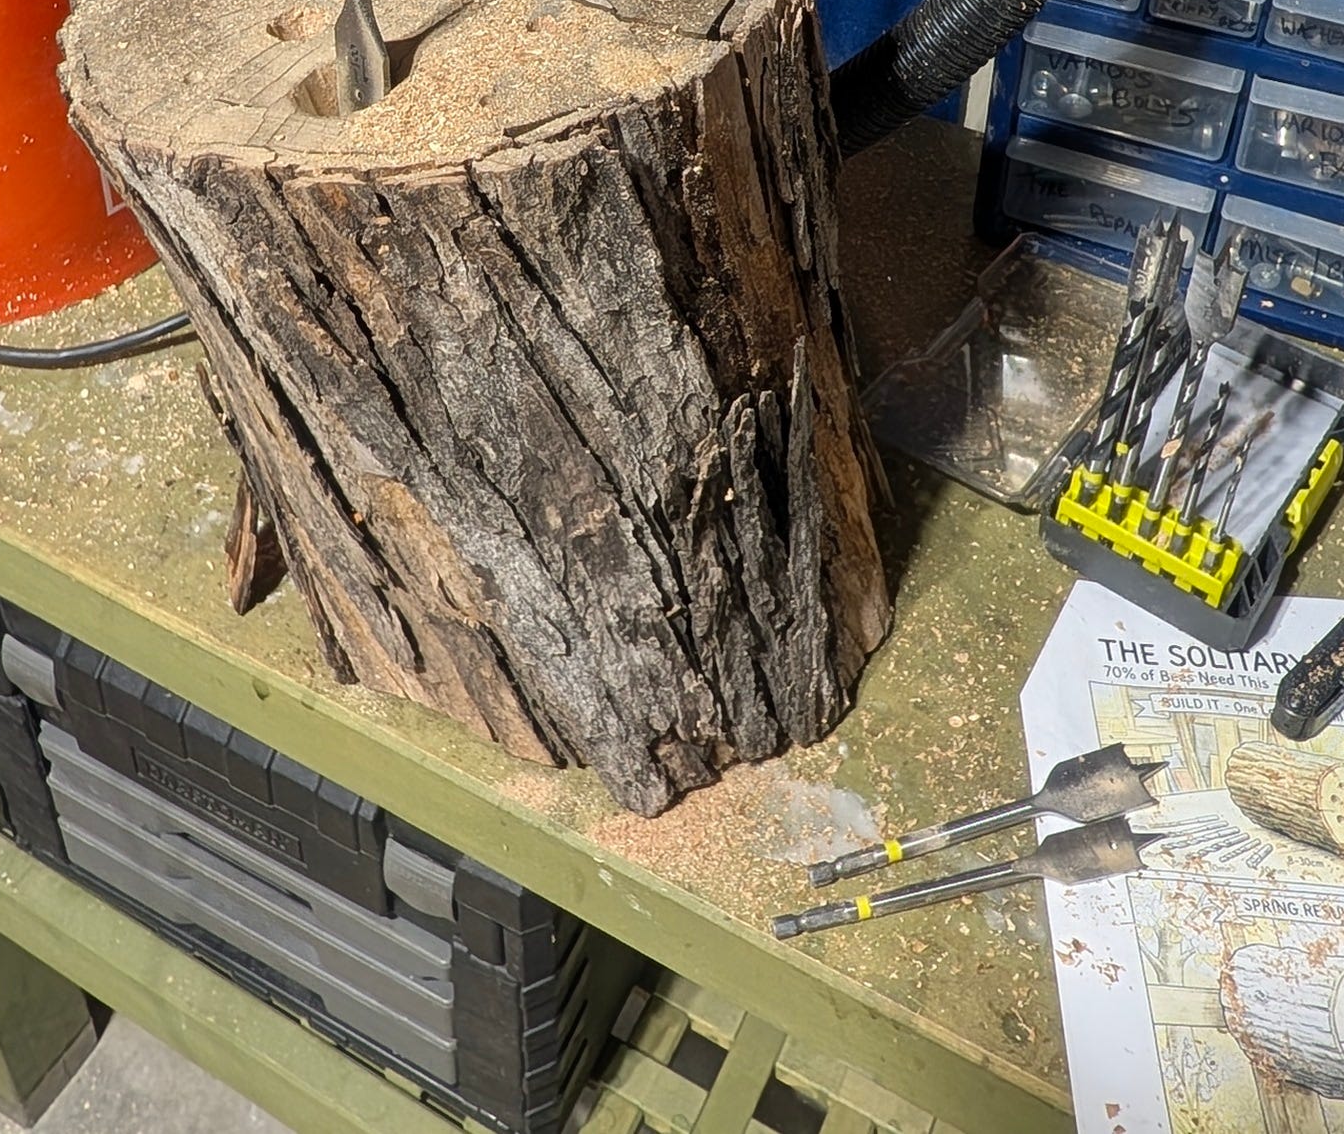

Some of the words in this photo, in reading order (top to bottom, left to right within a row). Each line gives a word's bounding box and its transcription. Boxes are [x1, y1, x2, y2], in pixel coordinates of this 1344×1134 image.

[1111, 88, 1199, 128] BOLTS
[1097, 638, 1156, 666] THE
[1104, 665, 1136, 679] 70%
[1141, 669, 1154, 682] of
[1160, 669, 1197, 684] Bees
[1199, 672, 1235, 687] Need
[1238, 674, 1269, 690] This
[1161, 697, 1204, 710] BUILD
[1207, 699, 1219, 710] IT
[1233, 701, 1258, 715] One
[1243, 898, 1299, 916] SPRING
